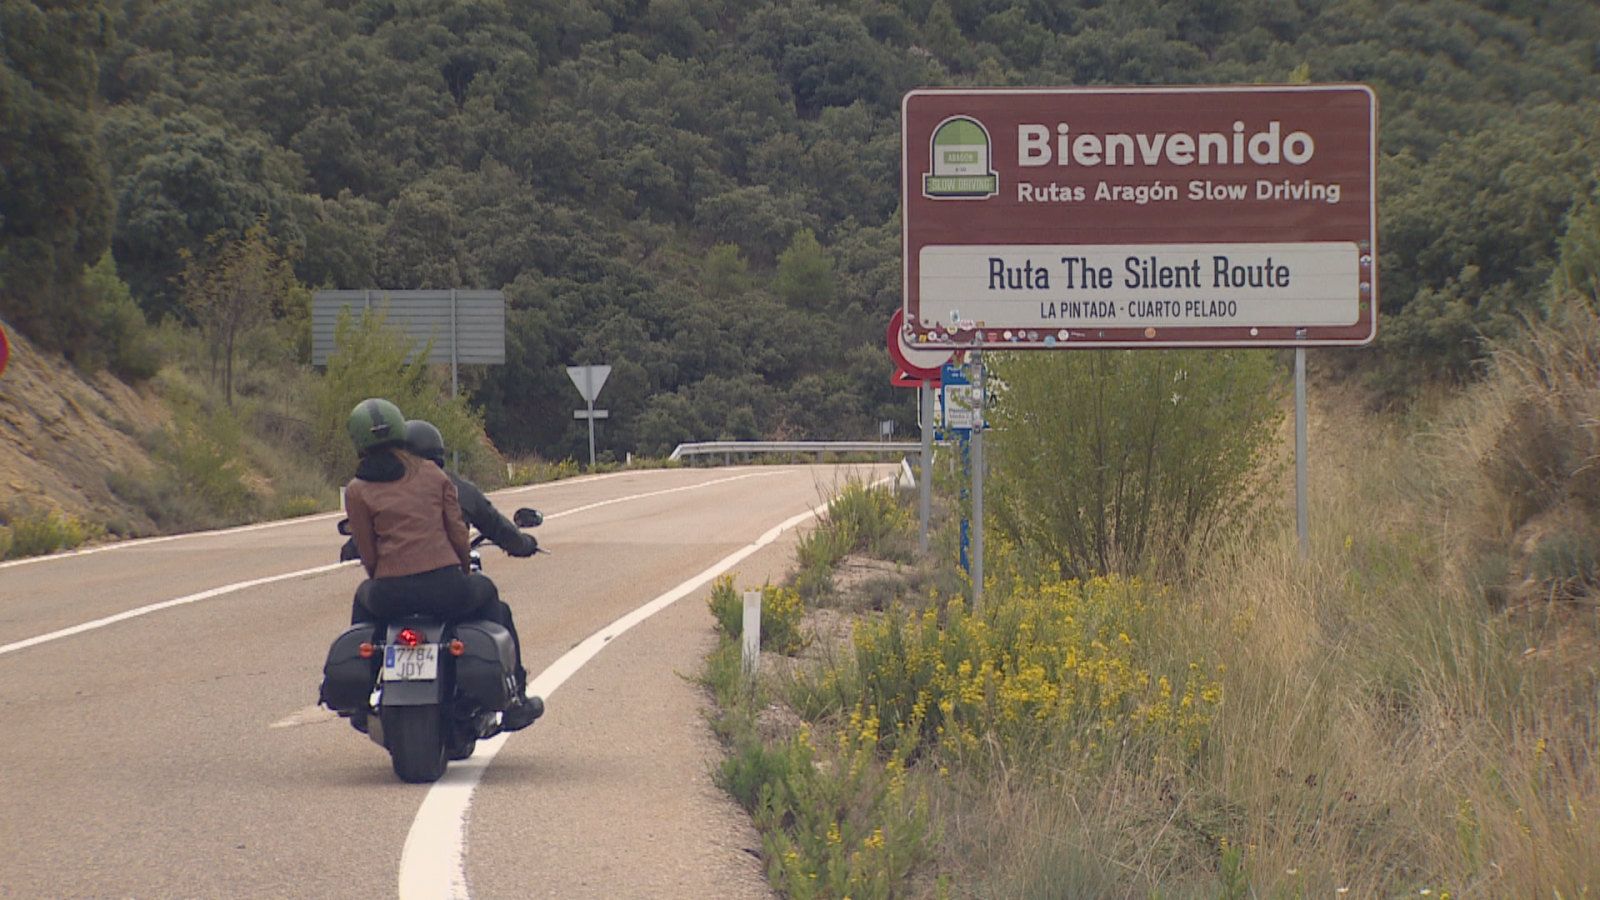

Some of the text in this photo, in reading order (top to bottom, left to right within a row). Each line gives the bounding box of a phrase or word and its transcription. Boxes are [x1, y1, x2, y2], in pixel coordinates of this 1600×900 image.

[1018, 120, 1315, 167] Bienvenido
[932, 177, 990, 191] SLOW DRIVING
[1017, 179, 1341, 204] Rutas Aragón Slow Driving
[988, 255, 1290, 290] Ruta The Silent Route
[1040, 302, 1057, 319] LA
[1060, 302, 1116, 319] PINTADA
[1128, 301, 1181, 318] CUARTO
[1185, 300, 1237, 318] PELADO
[396, 647, 434, 661] 7784
[396, 662, 424, 677] JDY
